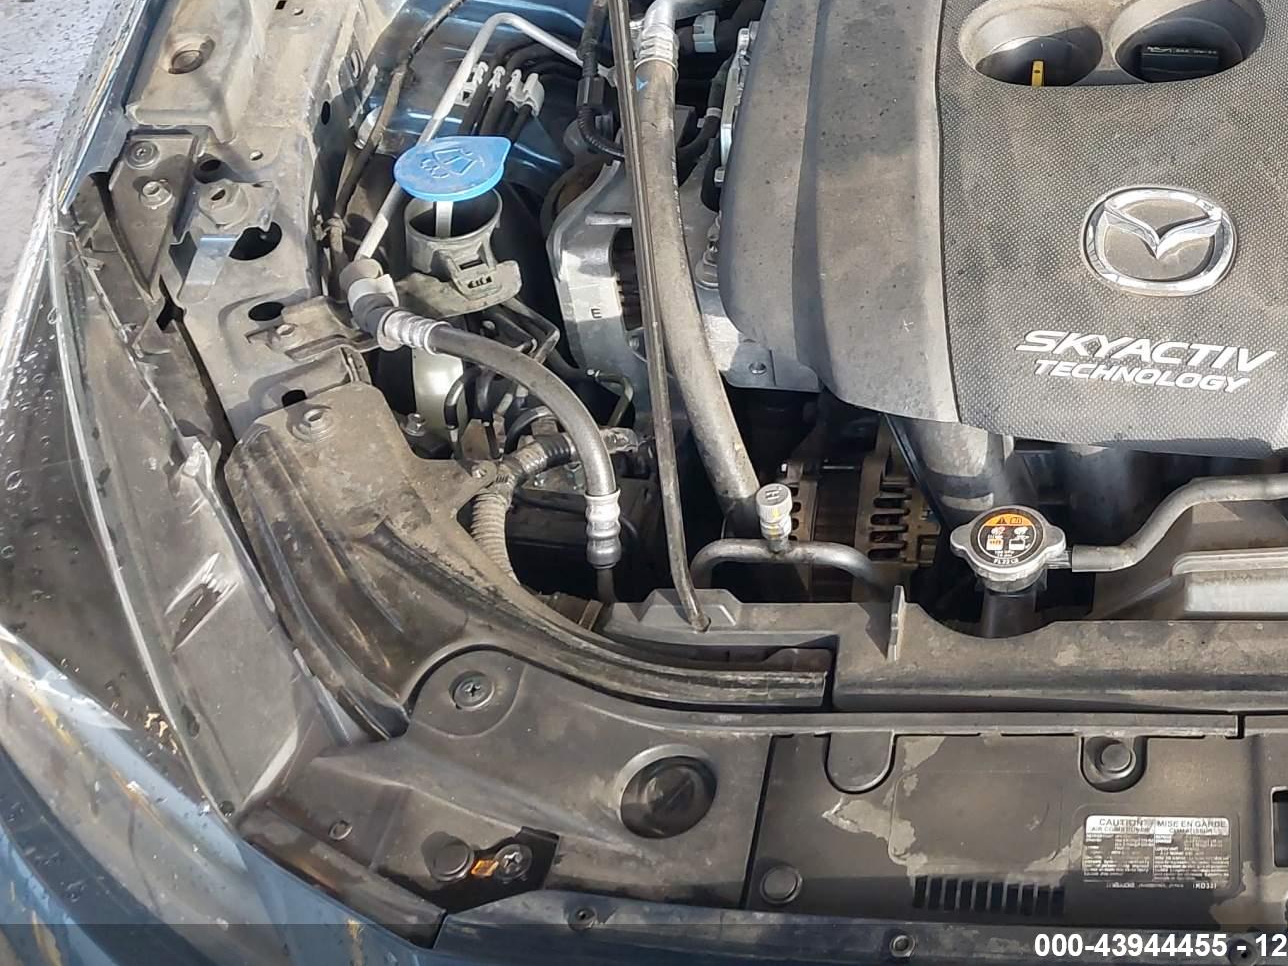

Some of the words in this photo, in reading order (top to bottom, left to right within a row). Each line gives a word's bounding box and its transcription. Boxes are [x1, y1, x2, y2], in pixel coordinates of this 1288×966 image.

[590, 307, 603, 320] E
[1016, 330, 1276, 372] SKYACTIV
[1034, 359, 1251, 393] TECHNOLOGY
[1099, 818, 1144, 827] CAUTION
[1157, 820, 1180, 828] MISE
[1181, 820, 1193, 828] EN
